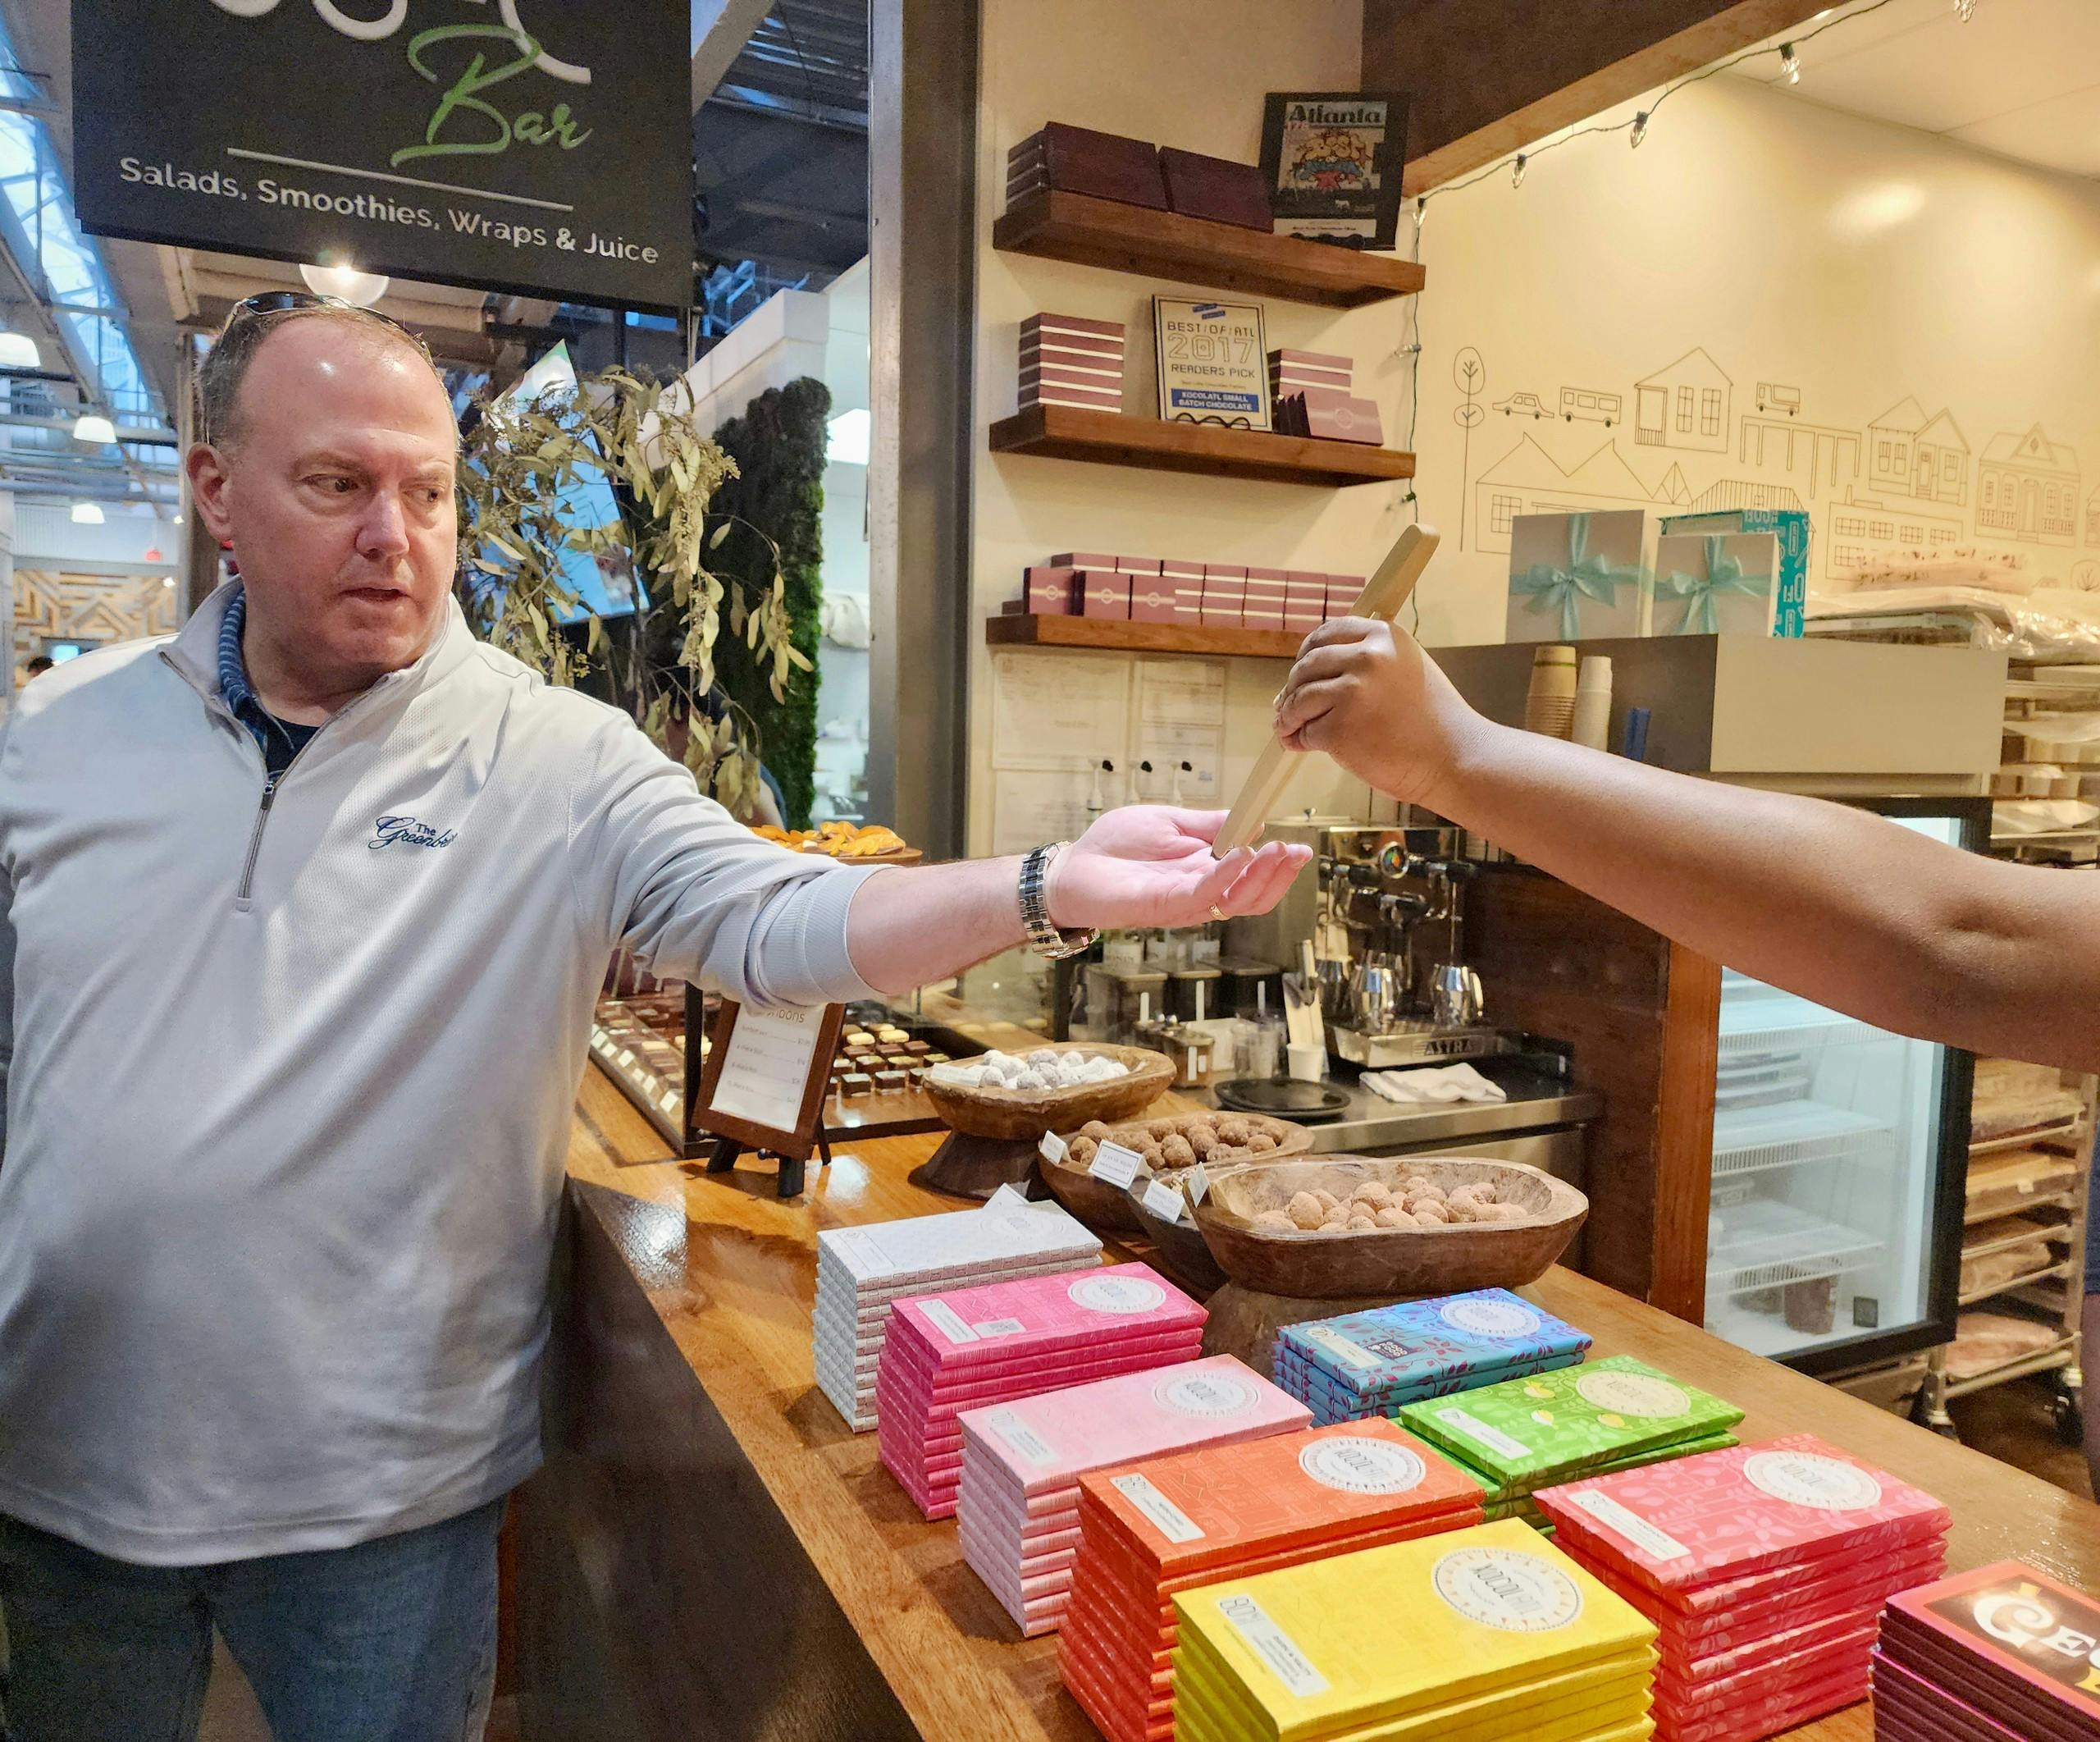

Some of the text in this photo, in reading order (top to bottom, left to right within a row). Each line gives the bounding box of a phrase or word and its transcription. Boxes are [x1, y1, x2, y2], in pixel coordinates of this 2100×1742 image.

[390, 24, 593, 167] Bar
[1290, 104, 1381, 124] Atlanta
[118, 156, 659, 264] Salads, Smoothies, Wraps & Juice
[1168, 332, 1254, 364] 2017
[1171, 363, 1255, 378] READERS PICK
[1179, 400, 1253, 411] BATCH CHOCOLATE
[1223, 394, 1249, 402] SMALL
[416, 823, 436, 836] The
